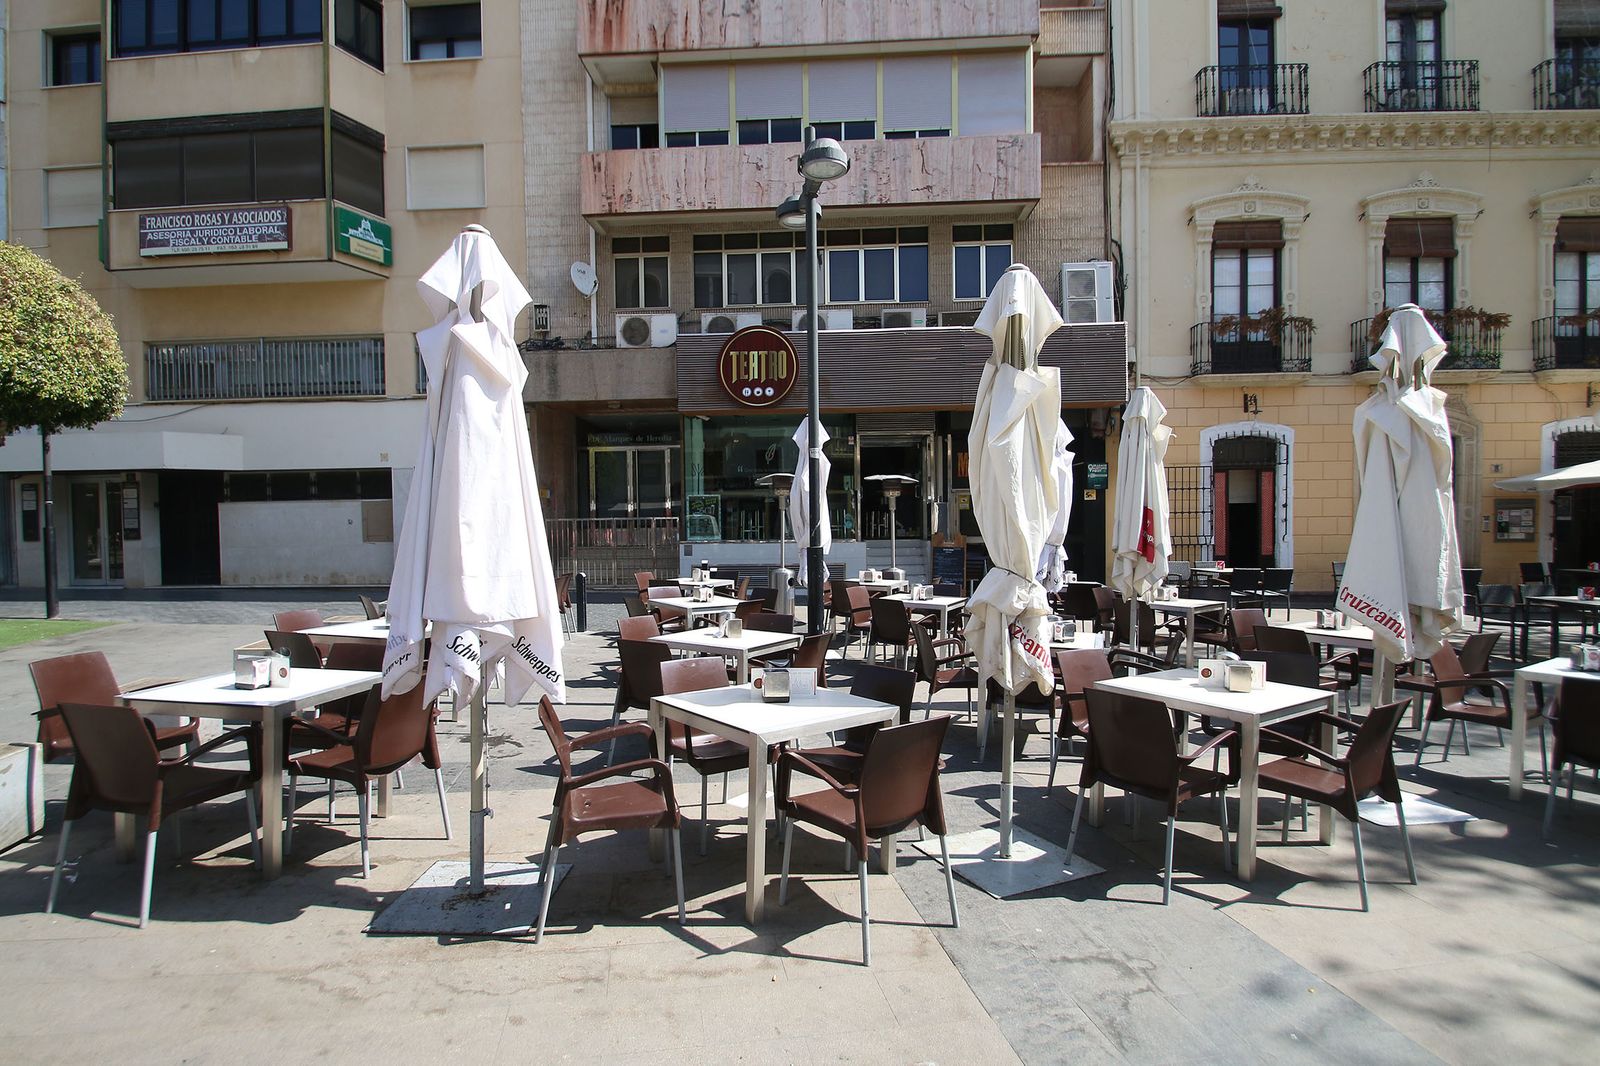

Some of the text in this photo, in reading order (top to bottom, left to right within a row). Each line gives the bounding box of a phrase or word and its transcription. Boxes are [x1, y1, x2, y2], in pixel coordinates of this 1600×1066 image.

[146, 210, 282, 229] FRANCISCO ROSAS Y ASOCIADOS
[147, 226, 280, 241] ASESORIA JURIDICO LABORAL
[170, 234, 259, 247] FISCAL Y CONTABLE
[730, 350, 787, 384] TEATRO
[1340, 586, 1407, 639] Cruzcamp
[511, 635, 562, 684] Schweppes
